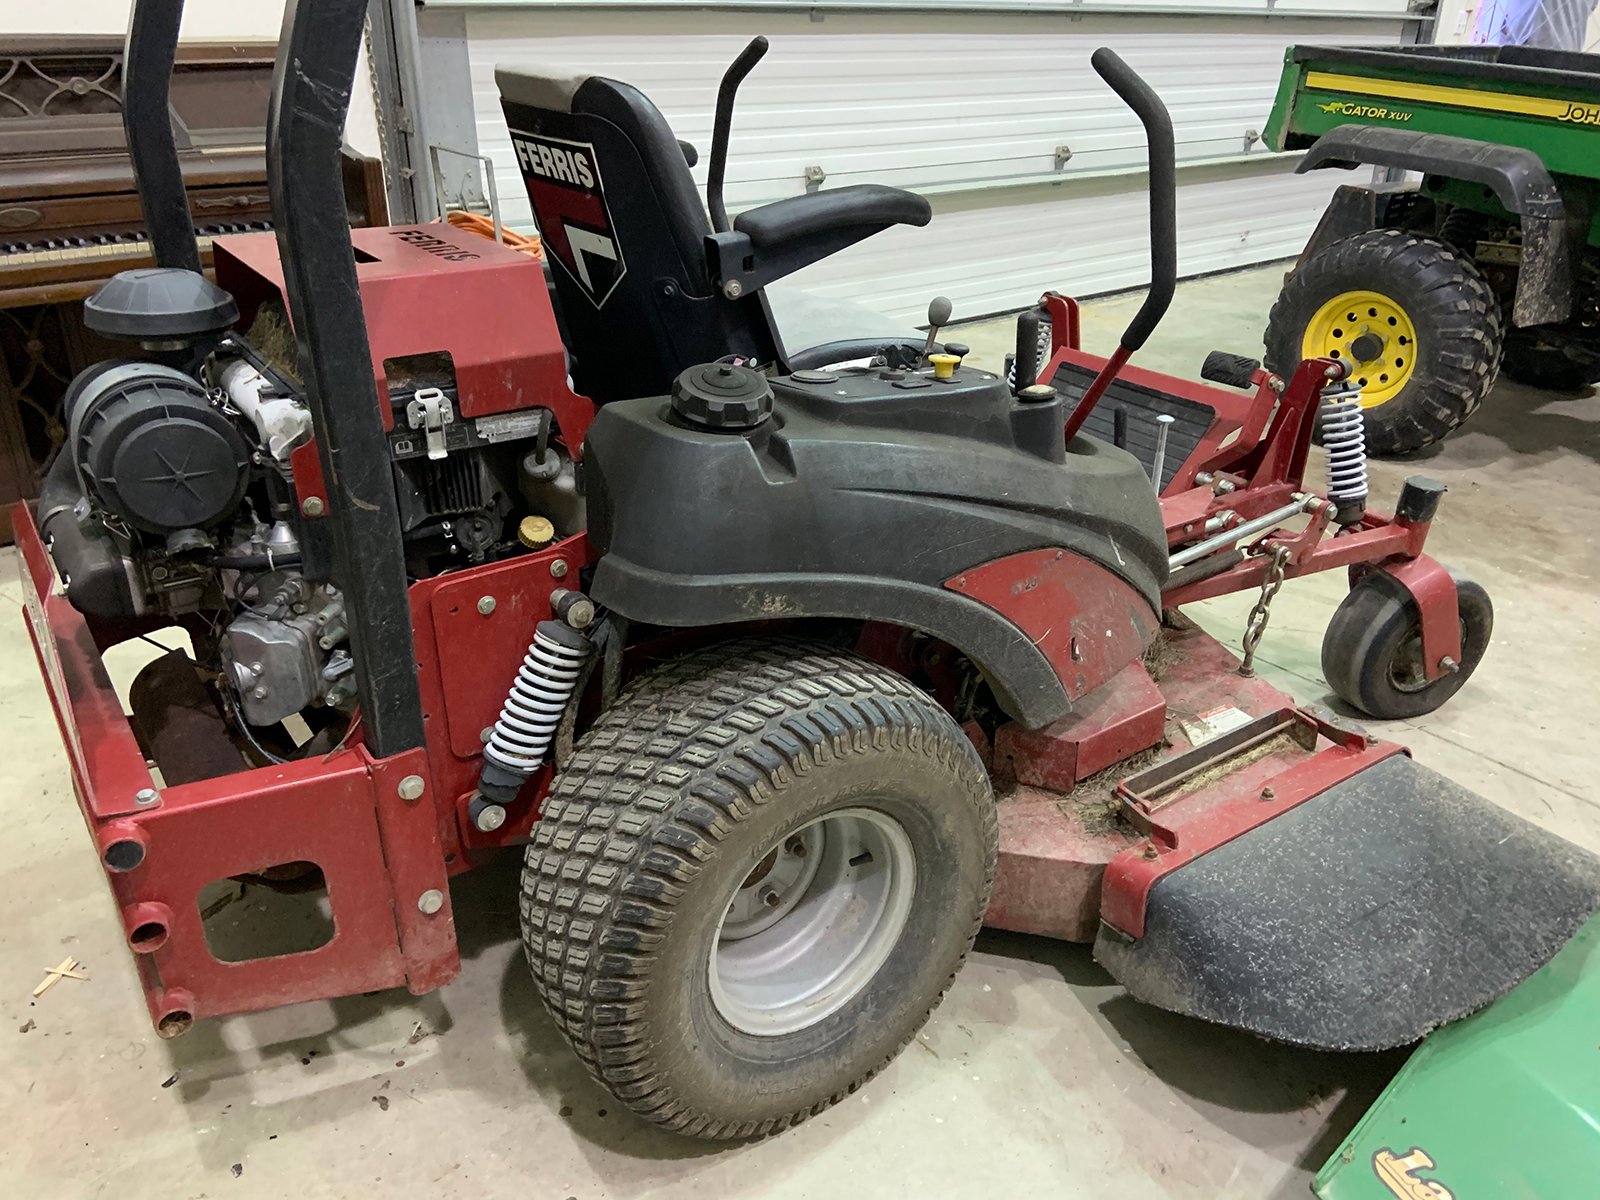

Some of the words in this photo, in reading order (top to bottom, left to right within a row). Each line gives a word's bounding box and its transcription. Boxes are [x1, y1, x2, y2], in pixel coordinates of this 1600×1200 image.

[1342, 103, 1387, 119] GATOR
[1388, 111, 1412, 121] XUV
[1558, 103, 1600, 123] JOH
[513, 139, 595, 188] FERRIS
[389, 230, 480, 261] FERRIS
